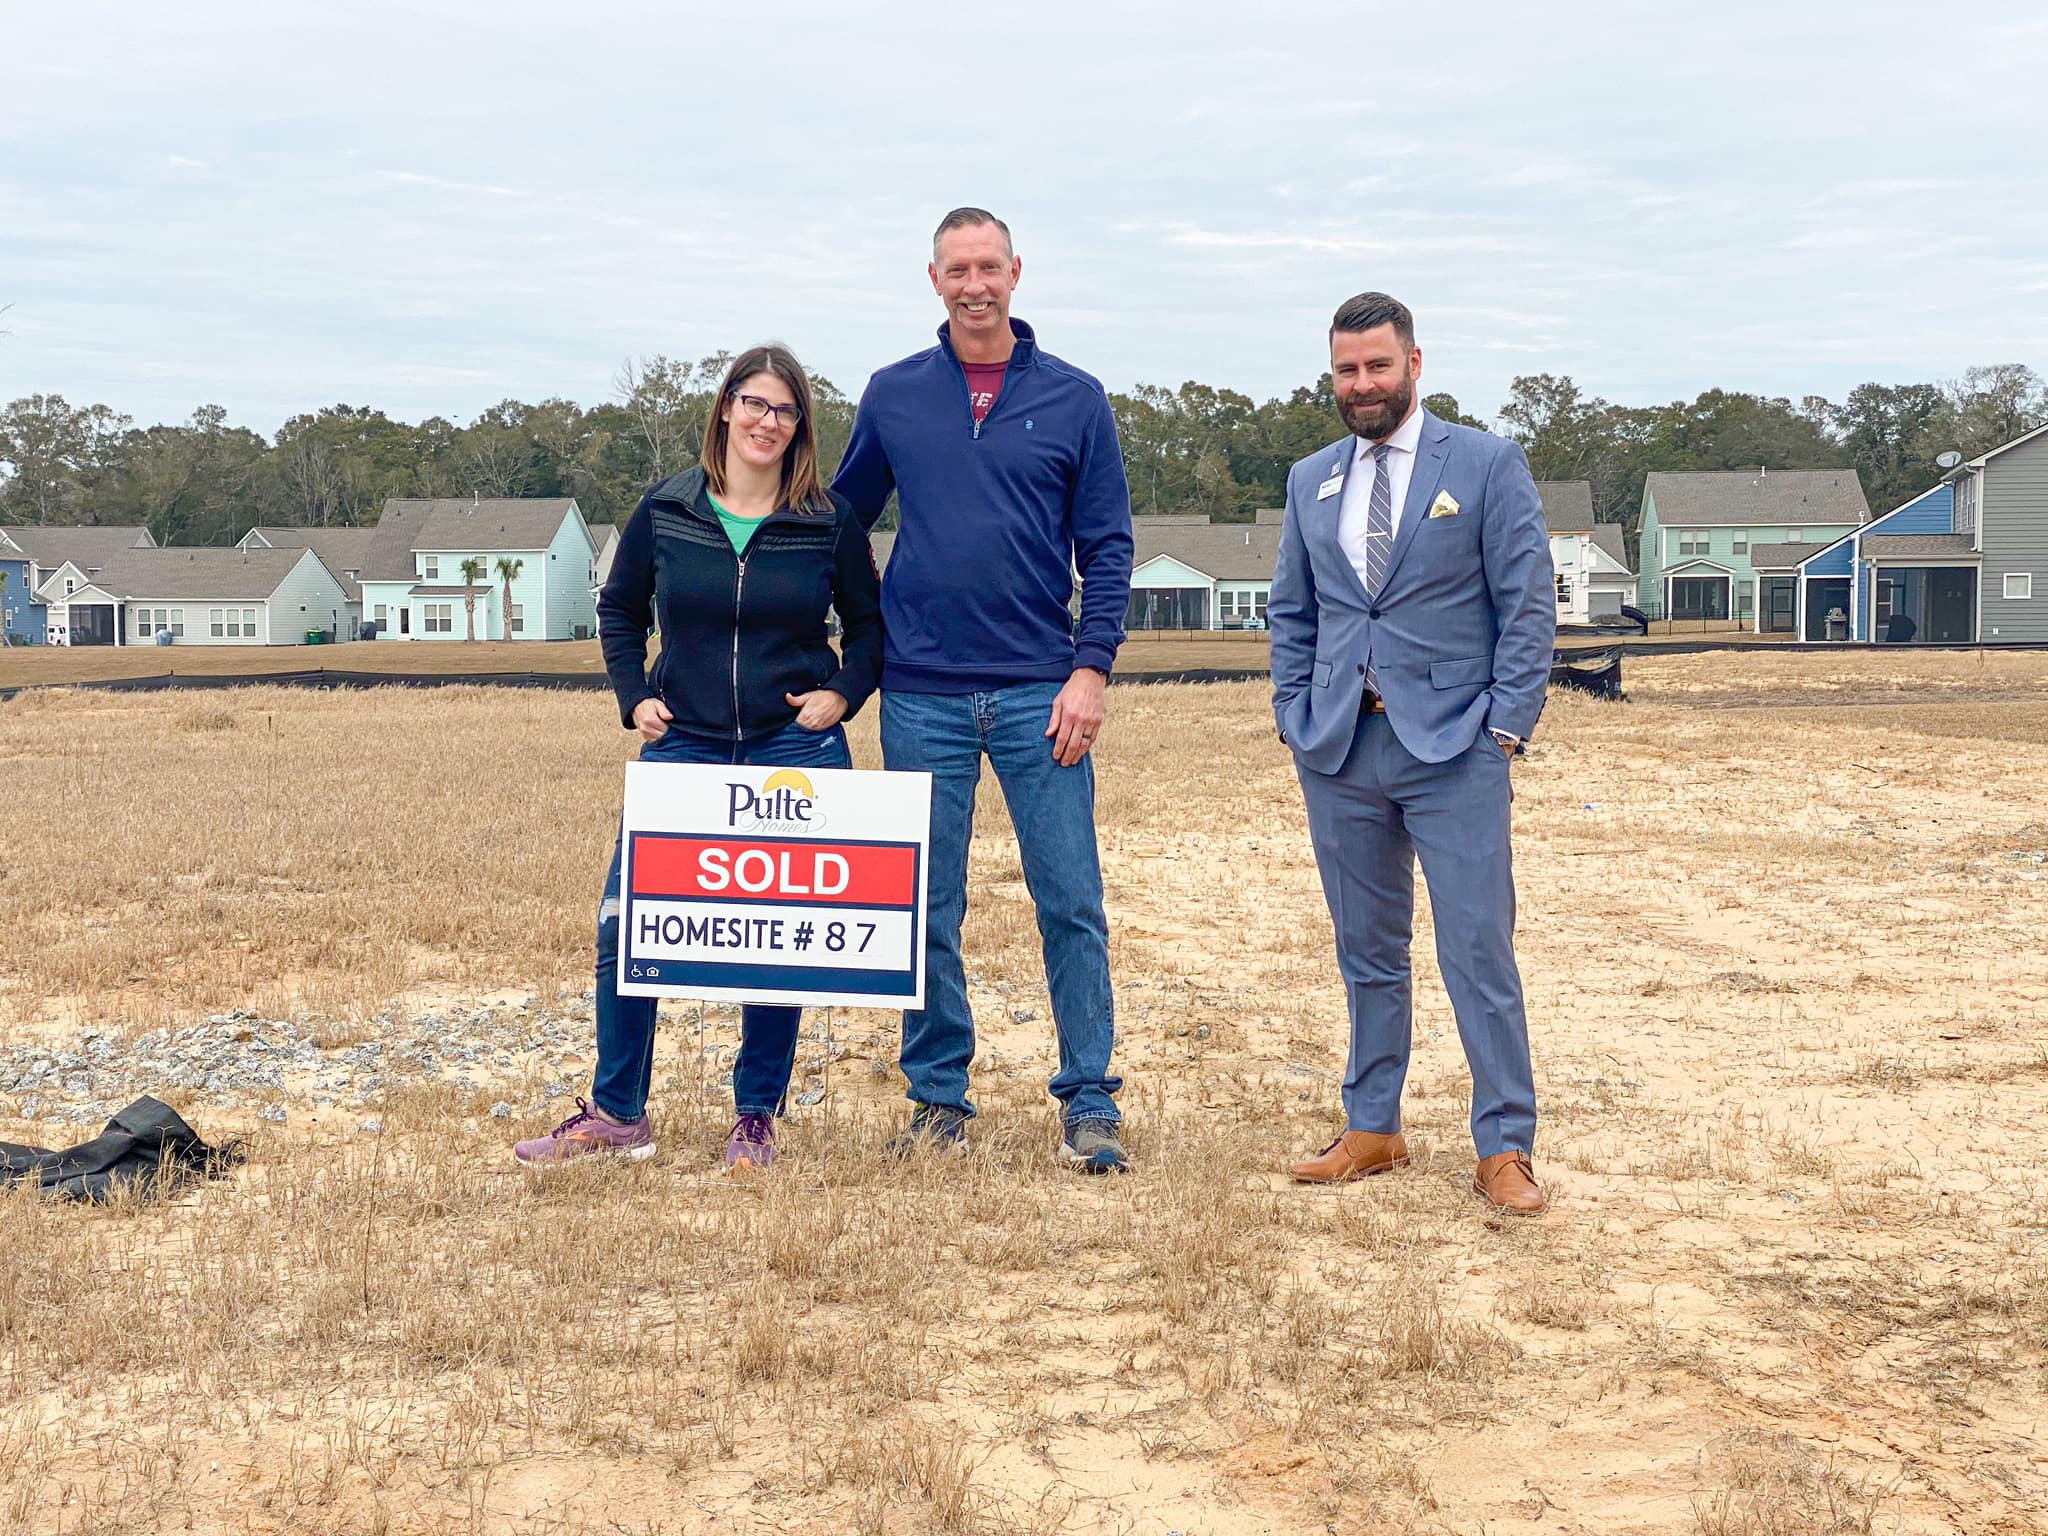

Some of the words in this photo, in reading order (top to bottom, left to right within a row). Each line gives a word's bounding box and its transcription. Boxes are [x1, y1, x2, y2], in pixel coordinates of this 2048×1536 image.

[725, 783, 813, 826] Pulte
[740, 812, 827, 833] Homes
[696, 847, 850, 895] SOLD
[640, 914, 785, 950] HOMESITE
